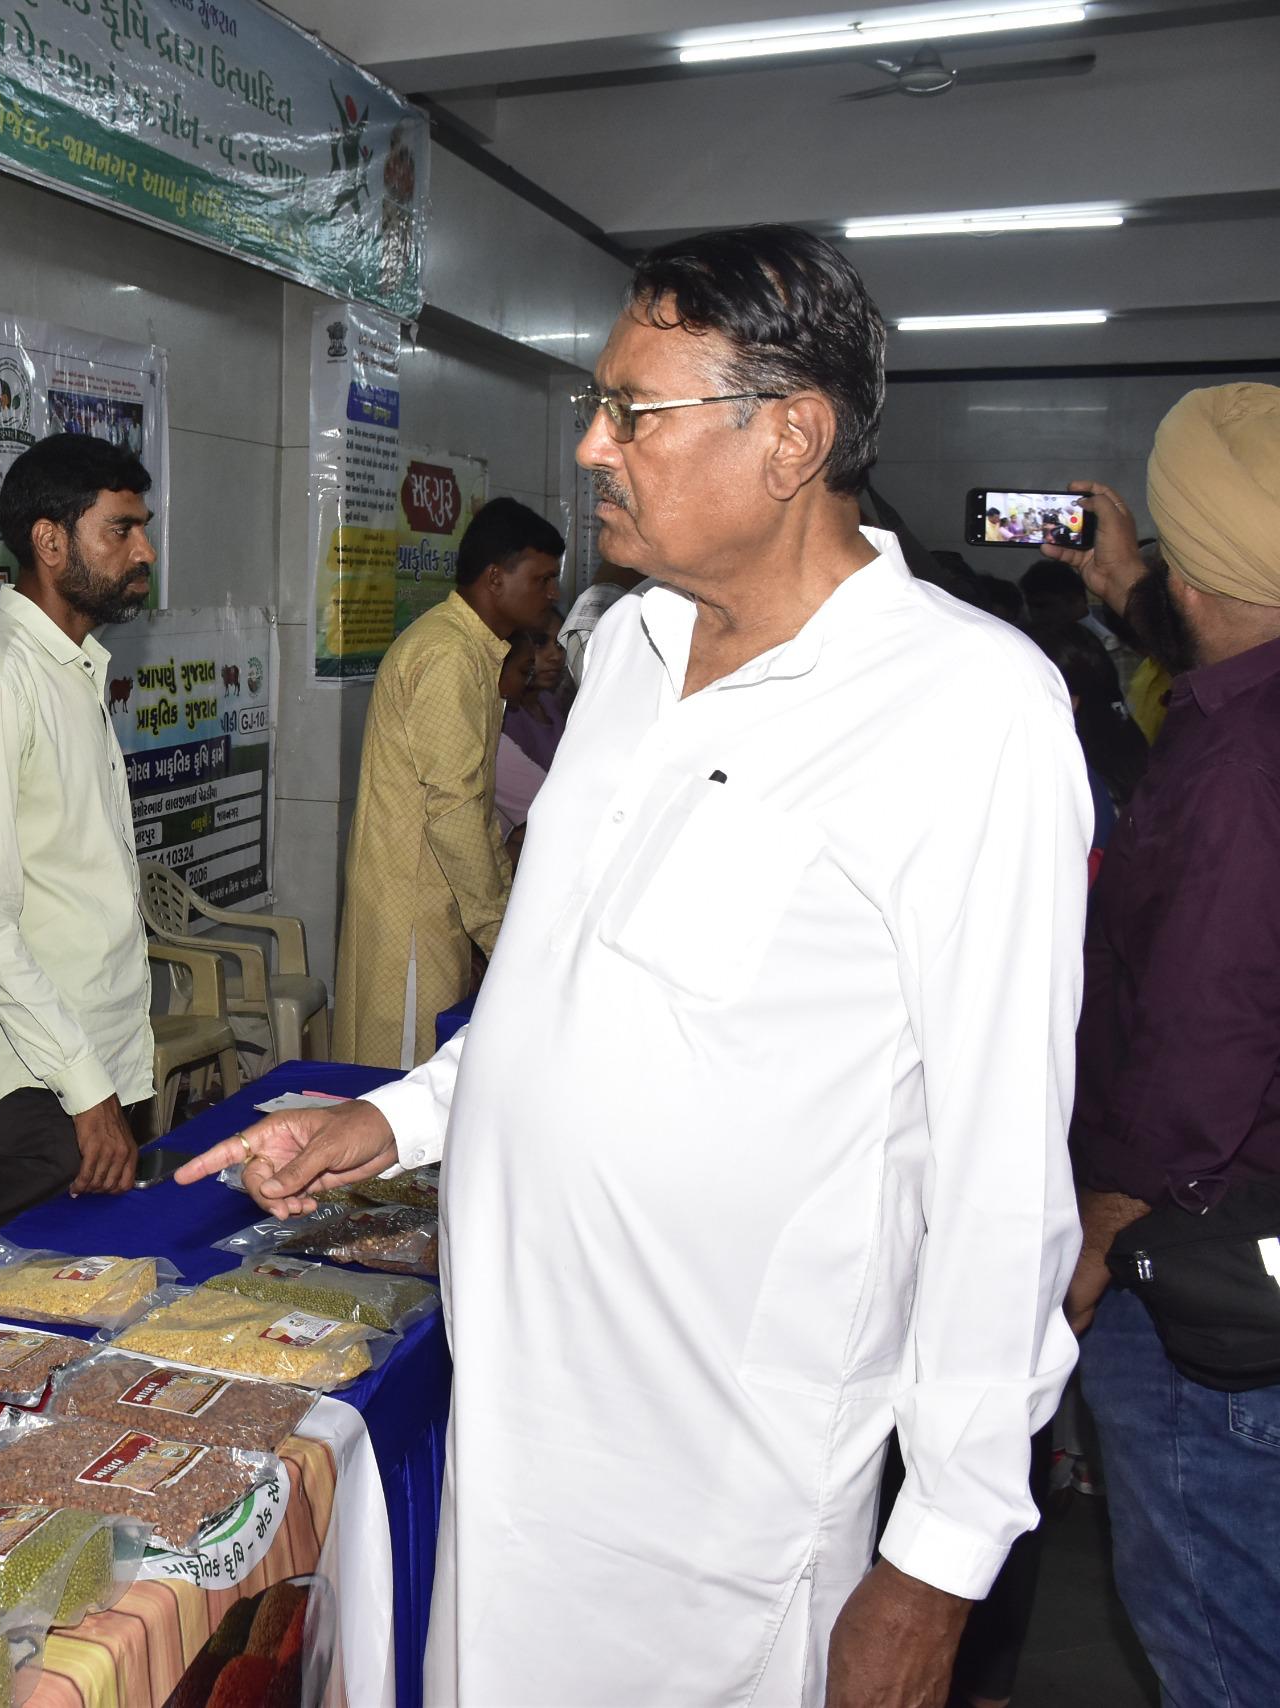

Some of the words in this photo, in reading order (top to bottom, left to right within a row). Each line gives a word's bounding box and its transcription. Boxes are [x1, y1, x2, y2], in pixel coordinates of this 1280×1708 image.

[211, 45, 293, 126] ઉત્પાદિત
[137, 658, 177, 694] આપણું
[181, 661, 216, 692] ગુજરાત
[136, 698, 178, 736] પ્રાકૃતિક
[185, 699, 218, 730] ગુજરાત
[241, 711, 265, 730] GJ-10
